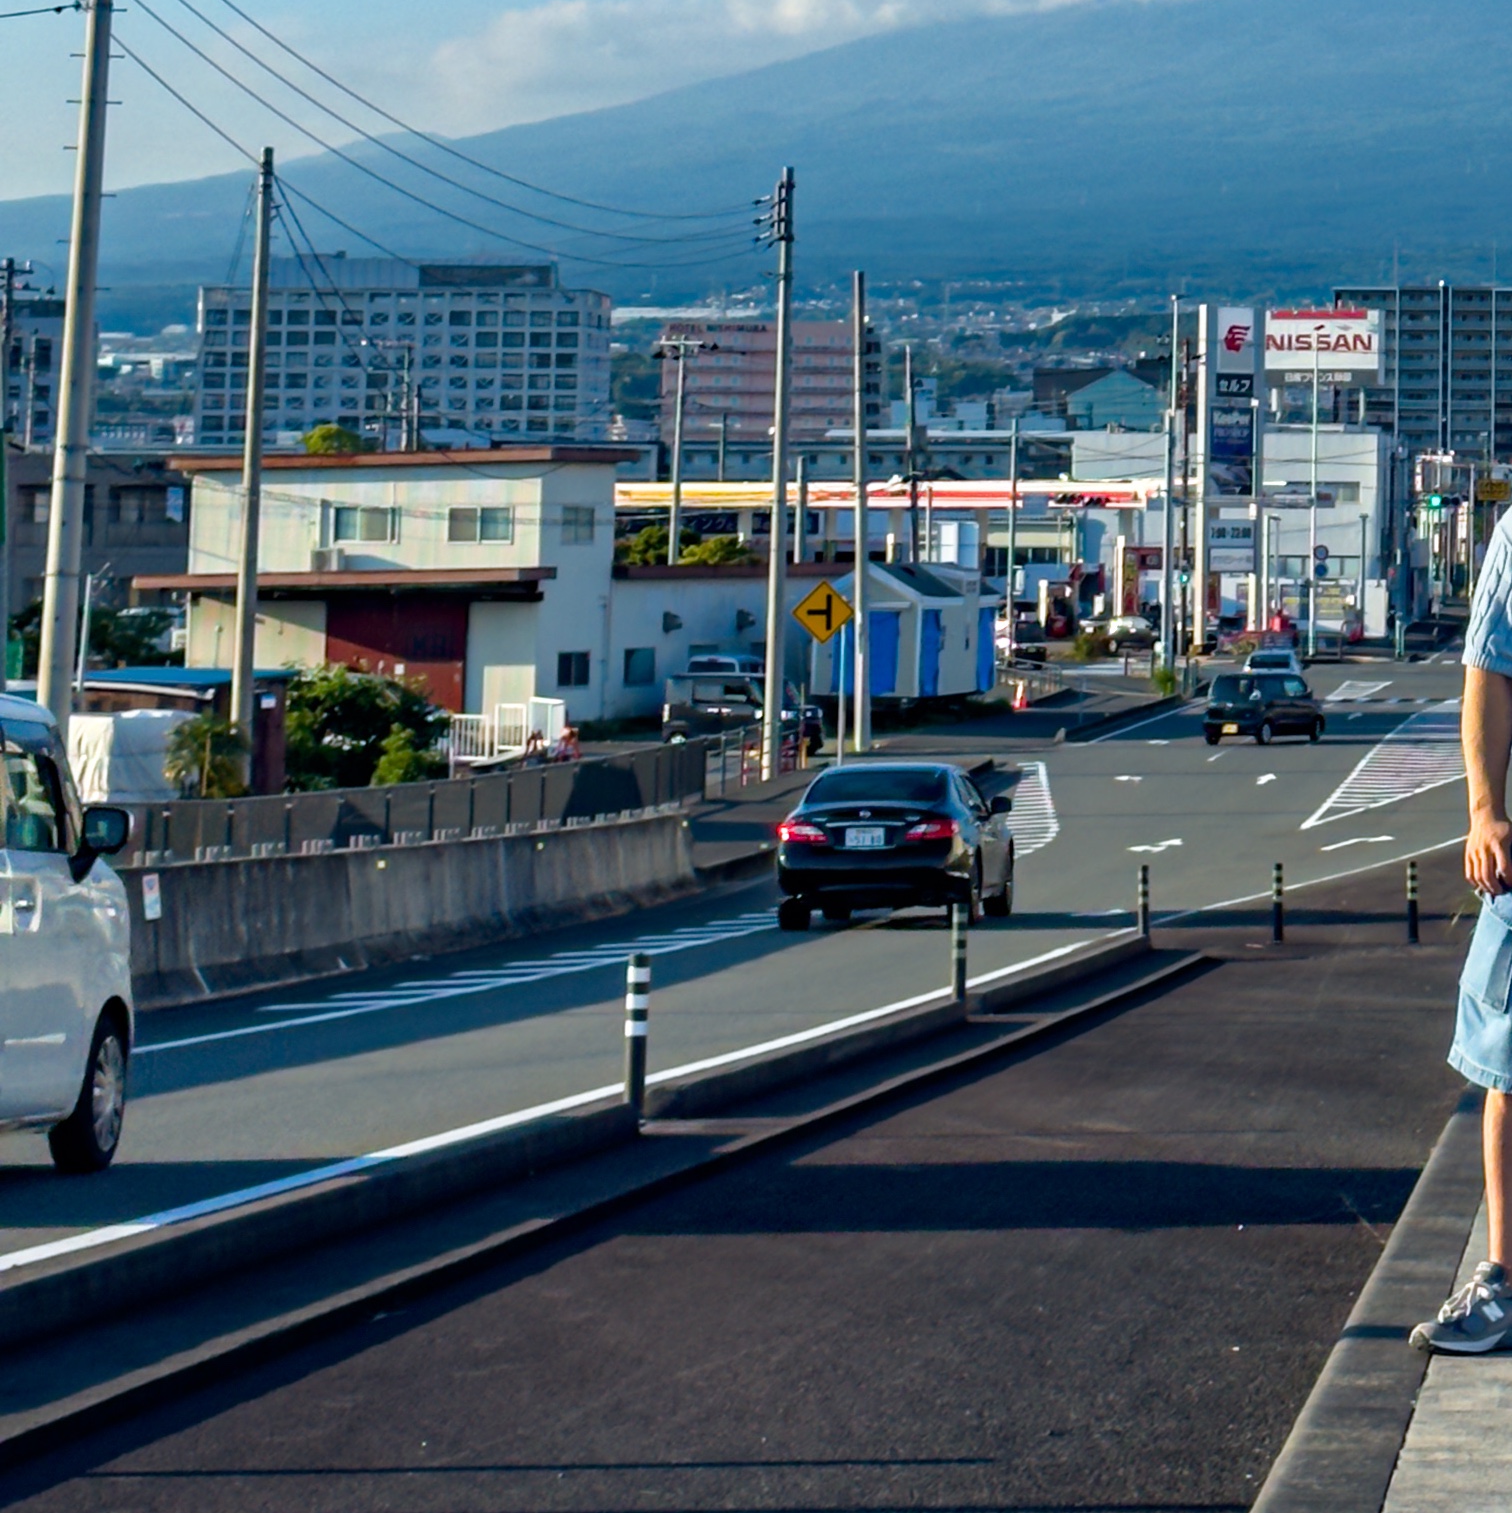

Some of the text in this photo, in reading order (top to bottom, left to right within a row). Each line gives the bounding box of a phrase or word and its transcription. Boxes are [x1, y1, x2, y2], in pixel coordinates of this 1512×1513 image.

[1266, 334, 1372, 351] NISSAN
[1219, 379, 1251, 393] セルフ
